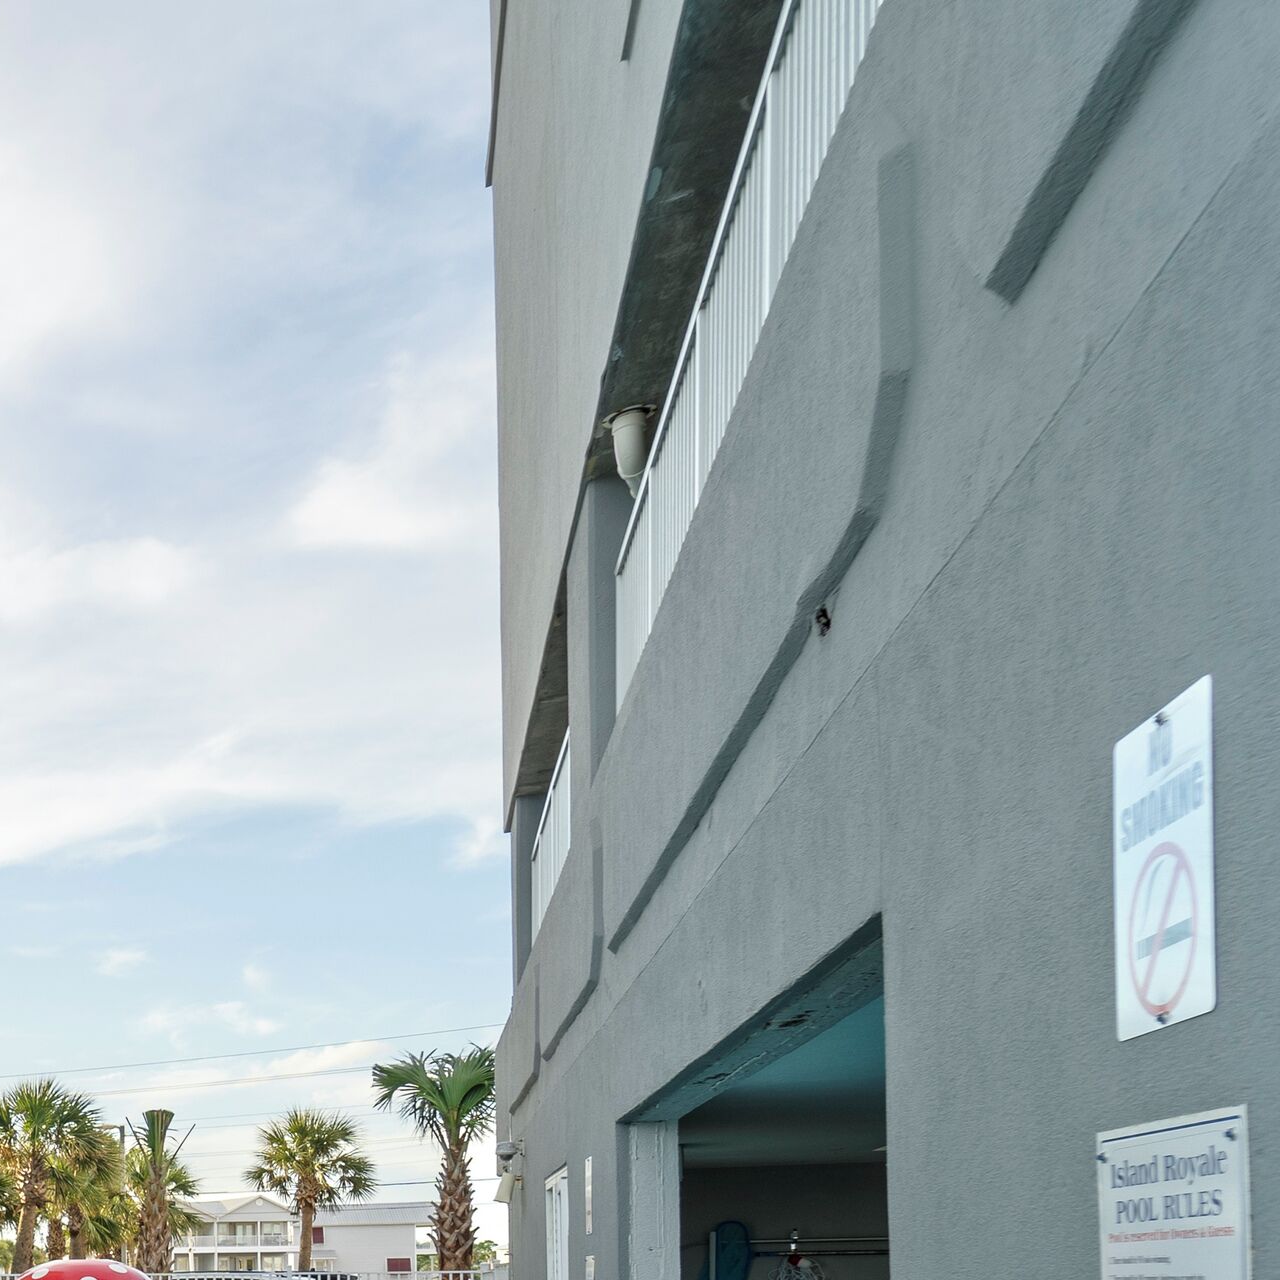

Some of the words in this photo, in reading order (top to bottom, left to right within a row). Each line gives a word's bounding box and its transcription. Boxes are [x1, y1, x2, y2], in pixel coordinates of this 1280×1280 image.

[1147, 721, 1172, 776] NO
[1121, 761, 1204, 853] SMOKING
[1111, 1155, 1158, 1188] Island
[1163, 1145, 1227, 1185] Royale
[1116, 1197, 1158, 1224] POOL
[1163, 1189, 1223, 1220] RULES
